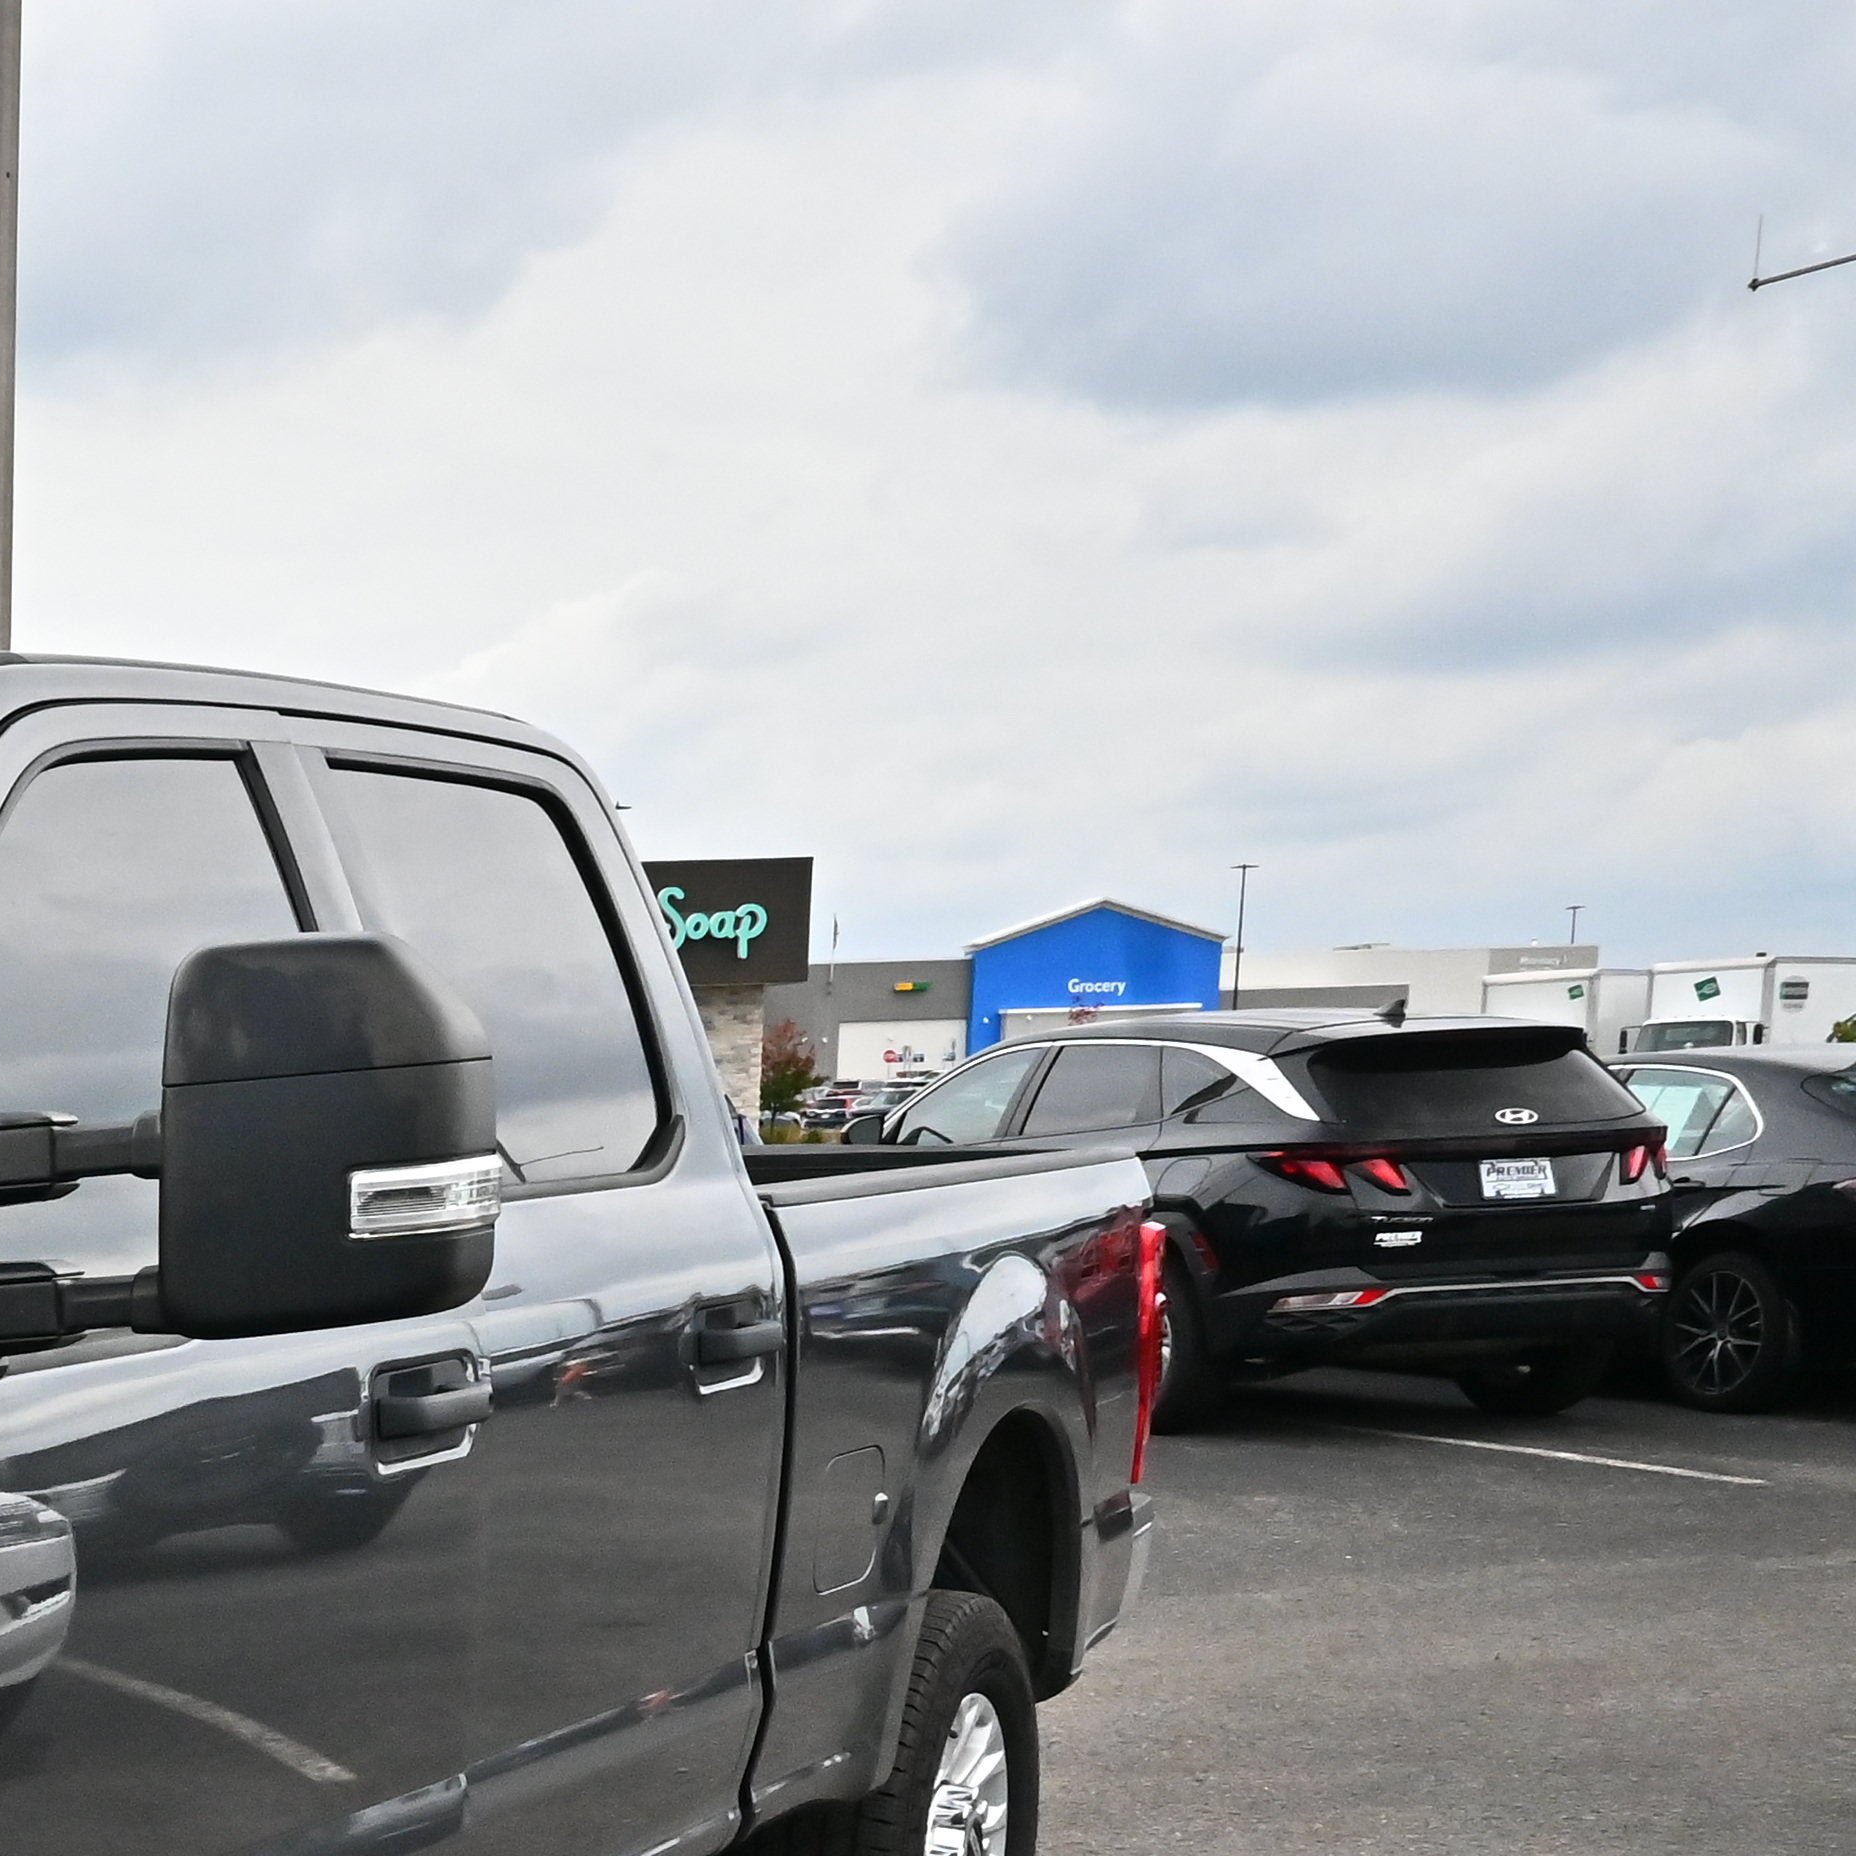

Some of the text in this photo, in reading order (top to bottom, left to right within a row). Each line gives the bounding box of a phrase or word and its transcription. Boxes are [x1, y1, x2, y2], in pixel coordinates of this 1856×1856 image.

[657, 886, 768, 960] Soap
[1067, 978, 1127, 997] Grocery
[1486, 1164, 1548, 1180] PREMIER
